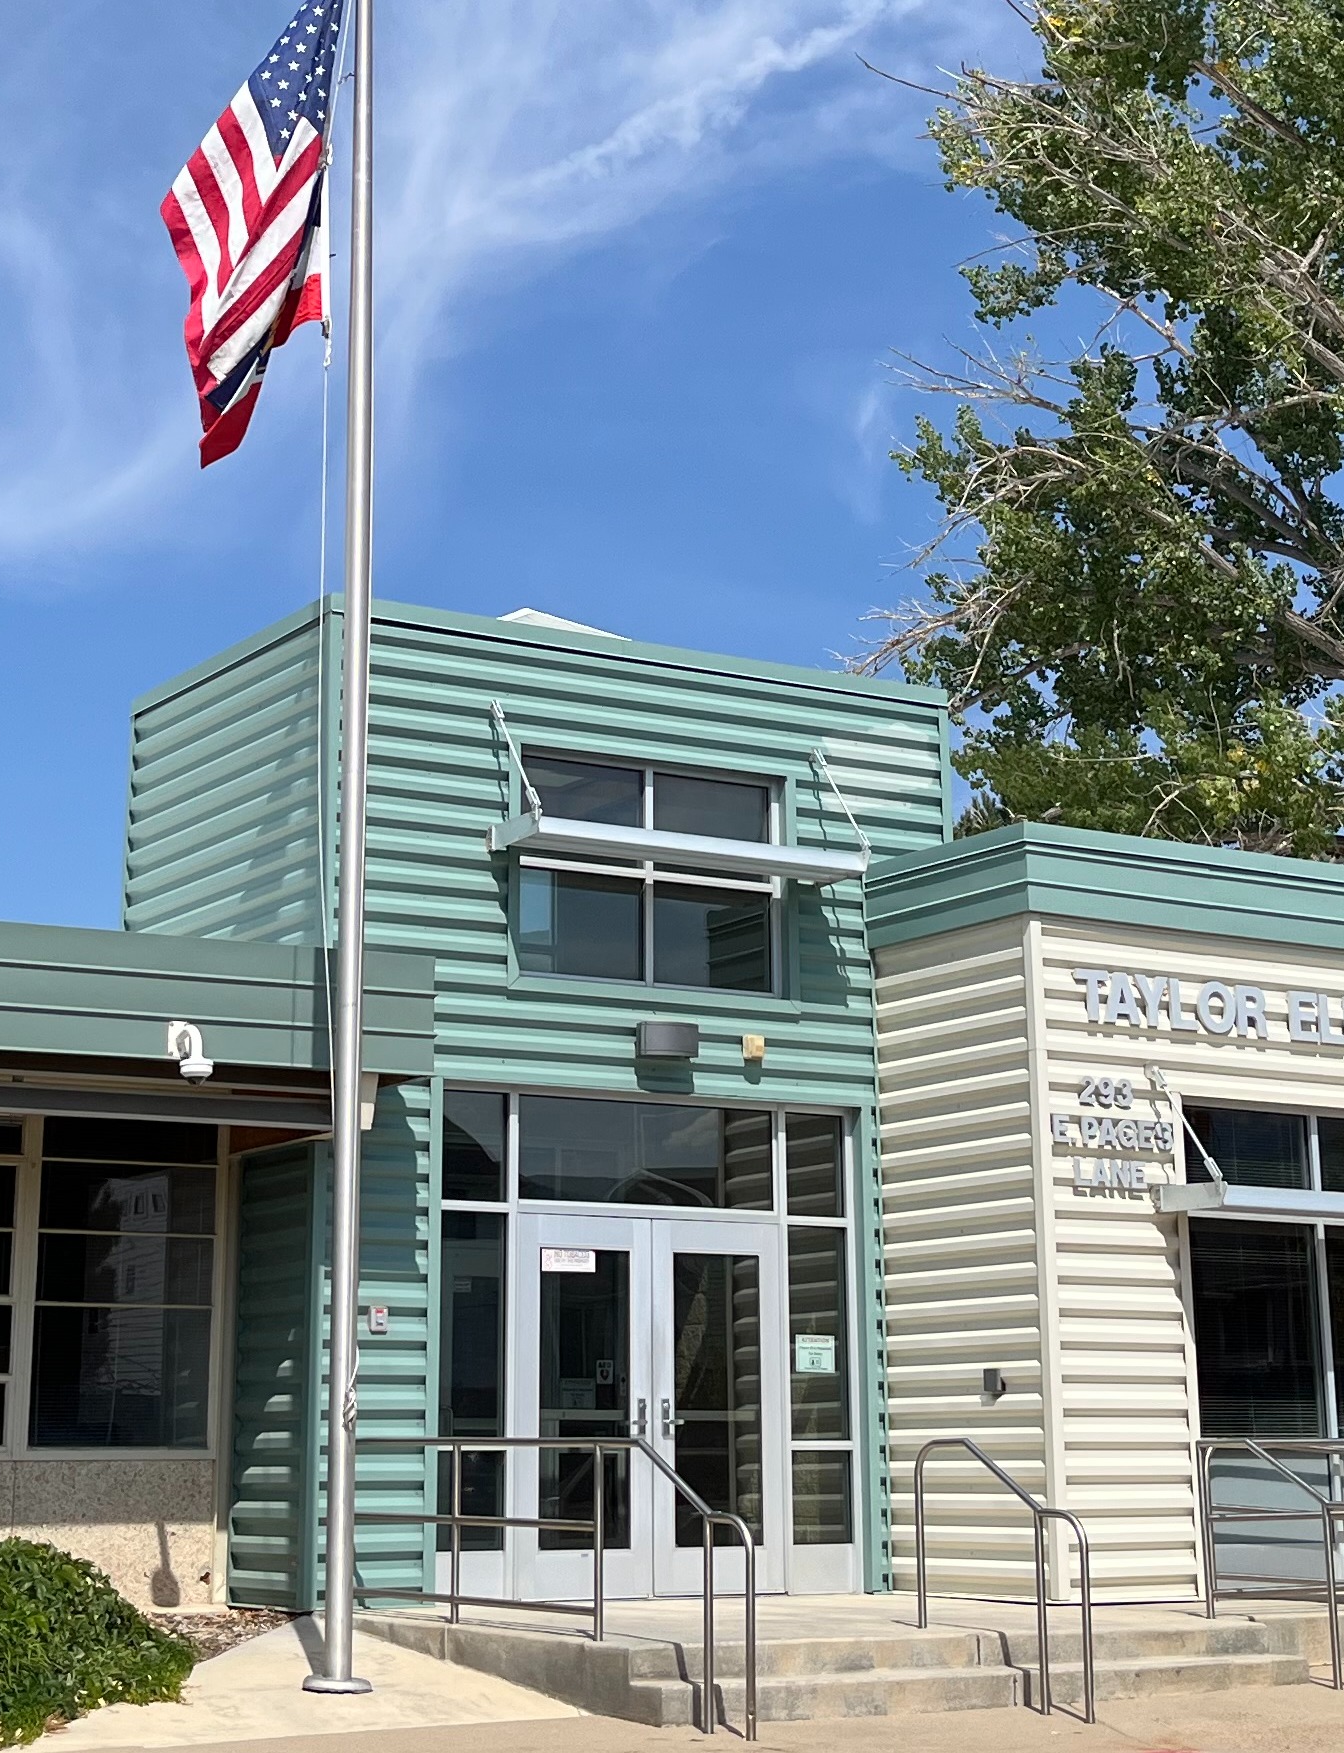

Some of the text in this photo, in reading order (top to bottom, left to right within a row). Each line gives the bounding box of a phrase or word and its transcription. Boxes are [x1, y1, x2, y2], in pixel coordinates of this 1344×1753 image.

[1071, 967, 1269, 1039] TAYLOR
[1077, 1075, 1134, 1106] 293
[1081, 1116, 1174, 1150] PAGES
[1073, 1156, 1148, 1188] LANE
